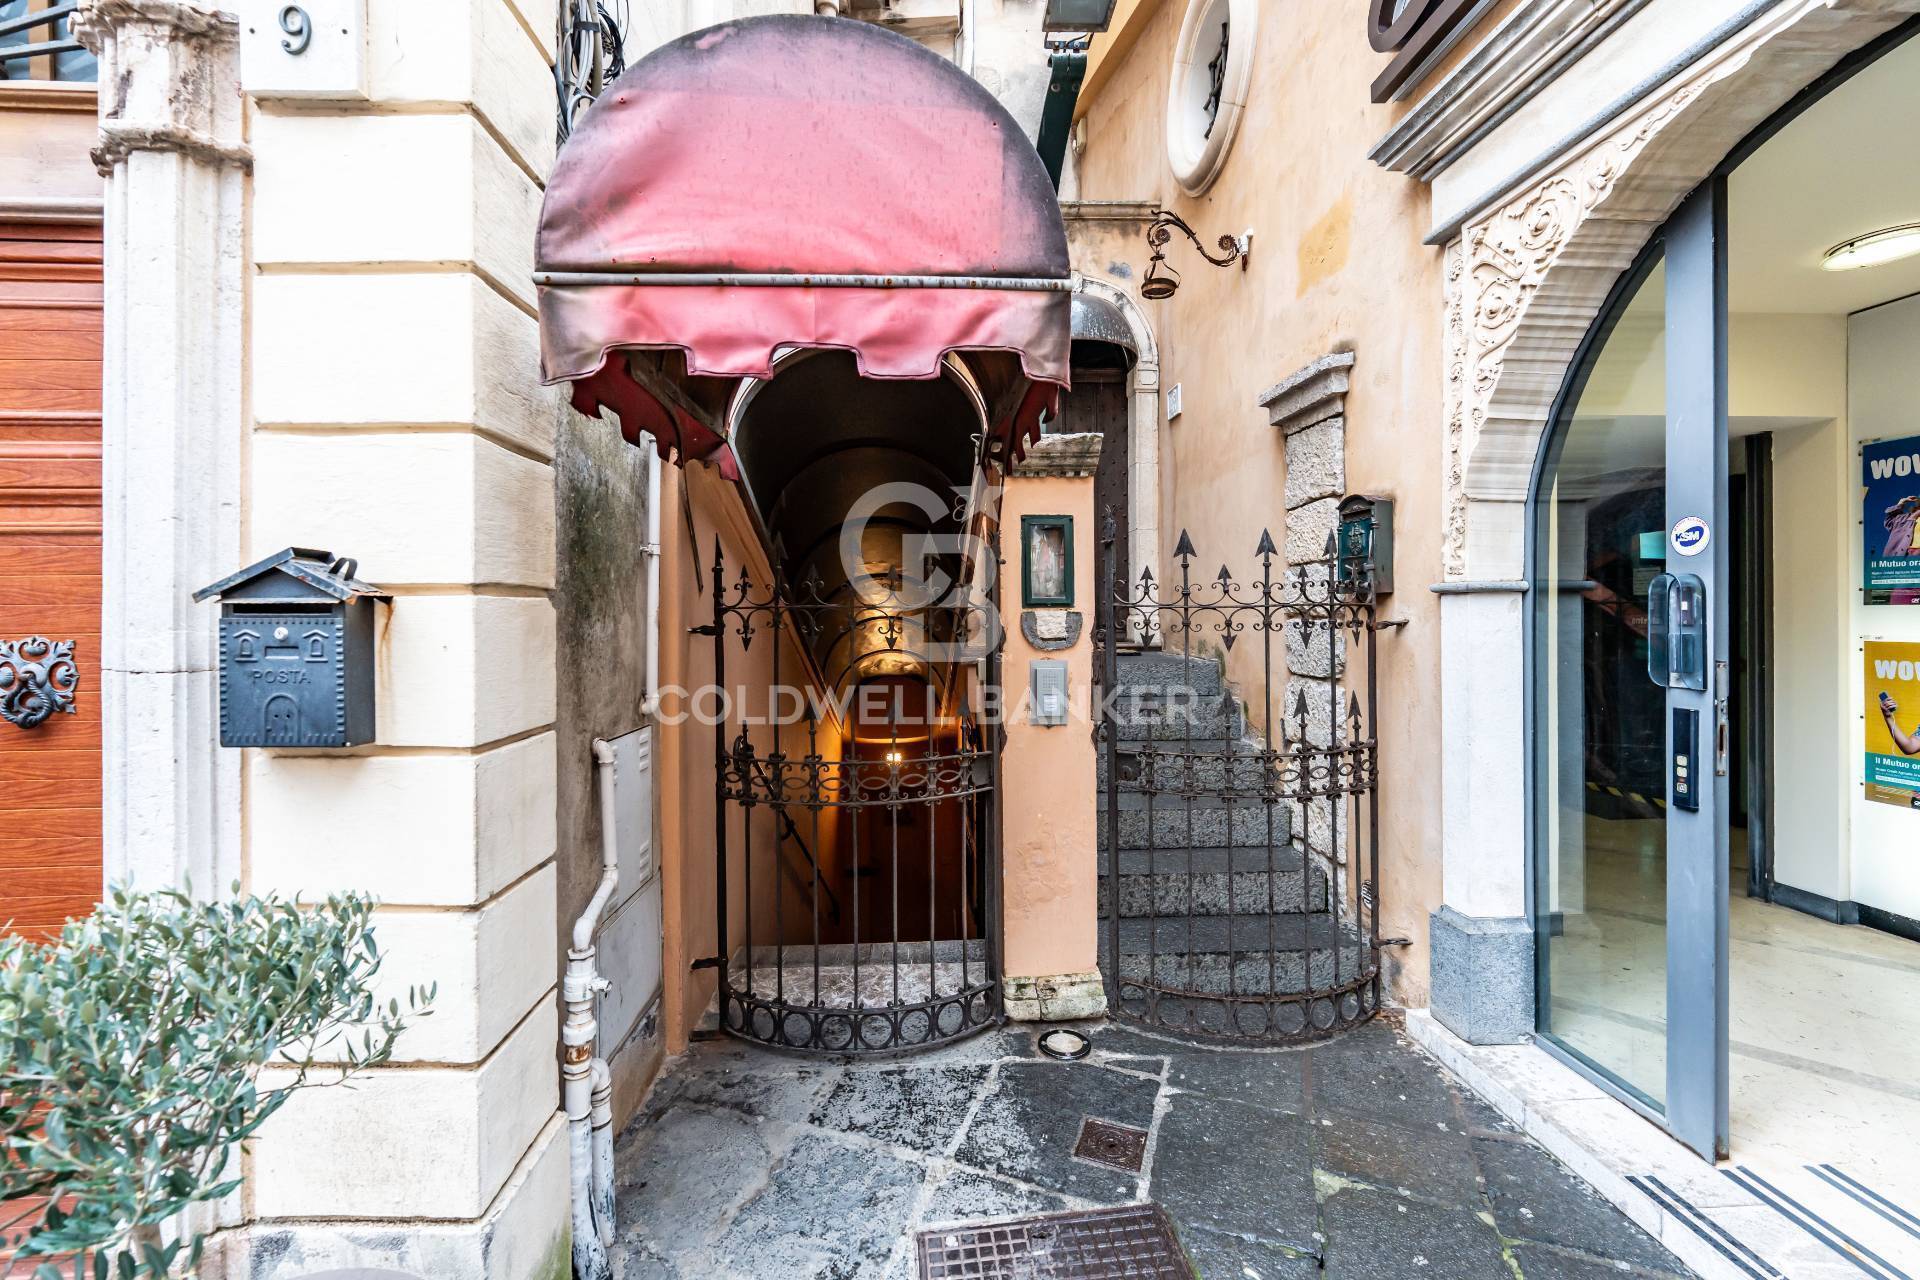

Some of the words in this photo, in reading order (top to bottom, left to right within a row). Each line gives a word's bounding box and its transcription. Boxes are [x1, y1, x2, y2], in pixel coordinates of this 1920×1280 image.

[278, 4, 312, 56] 9
[1879, 559, 1907, 568] Mutuo
[252, 669, 311, 685] POSTA
[1874, 659, 1920, 681] WO
[1882, 757, 1910, 769] Mutuo
